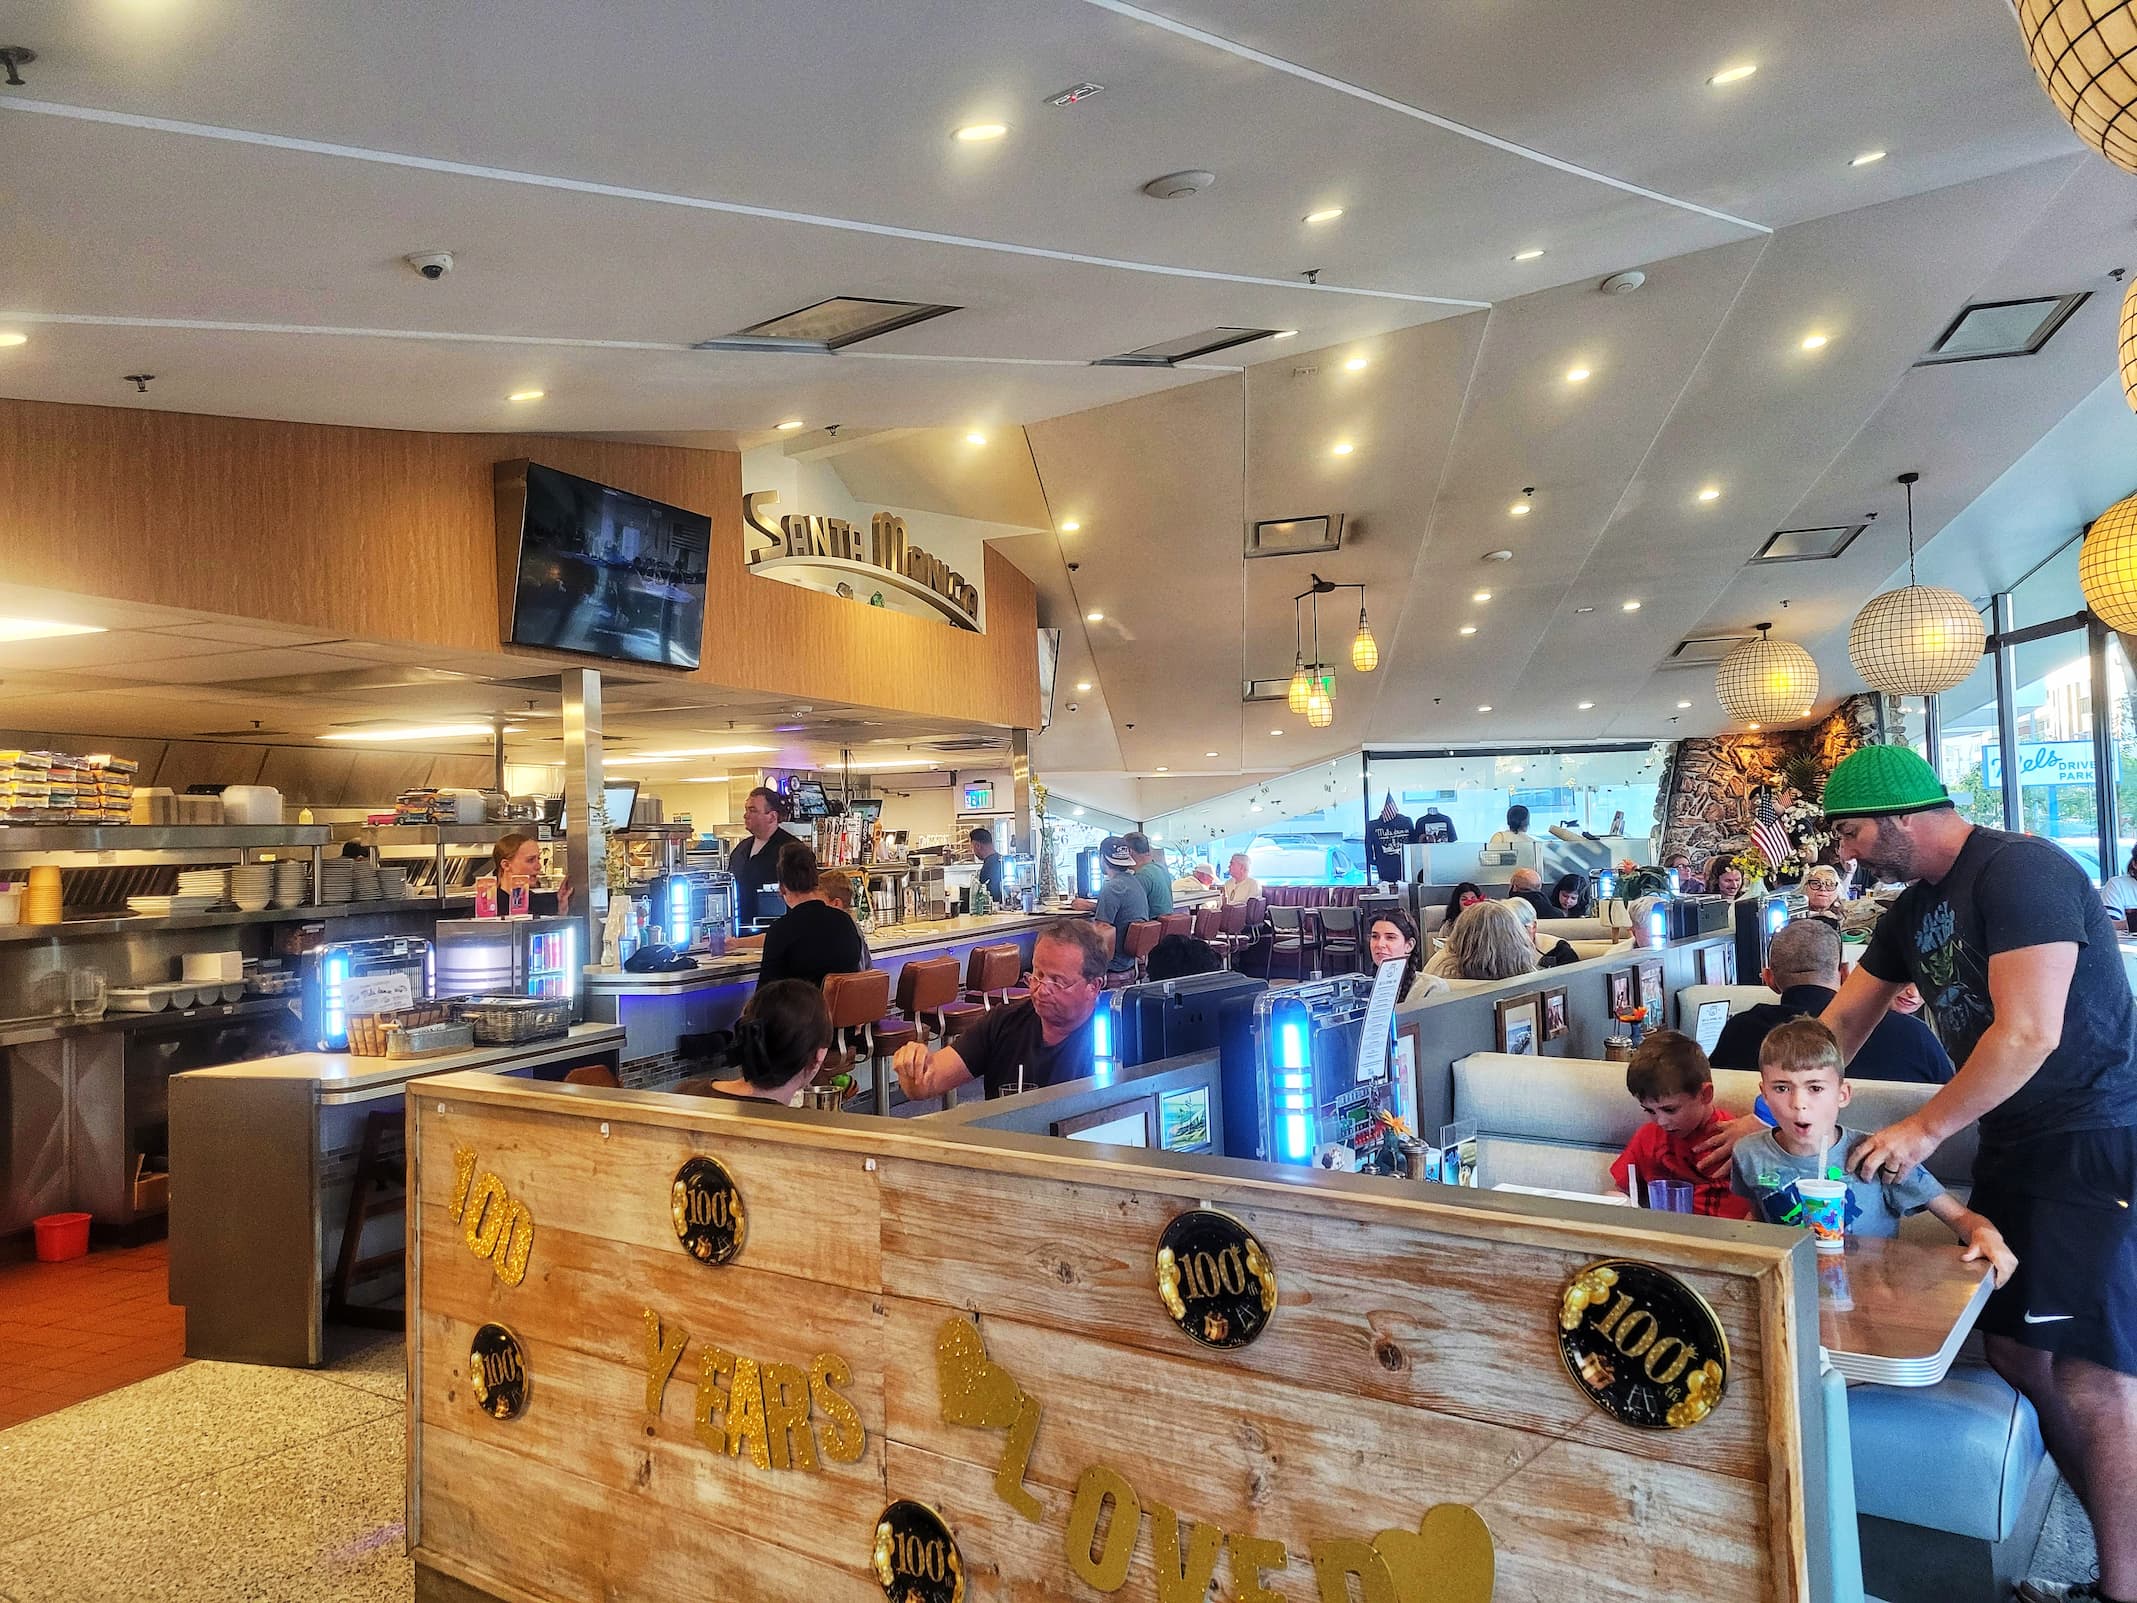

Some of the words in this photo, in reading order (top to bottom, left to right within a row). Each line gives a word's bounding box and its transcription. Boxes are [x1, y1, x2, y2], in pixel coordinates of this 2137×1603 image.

[743, 489, 866, 563] SANTA
[872, 511, 979, 621] MONICA
[2059, 772, 2095, 781] PARK
[449, 1144, 535, 1288] 100
[643, 1306, 866, 1472] YEARS
[995, 1390, 1399, 1603] LOVED
